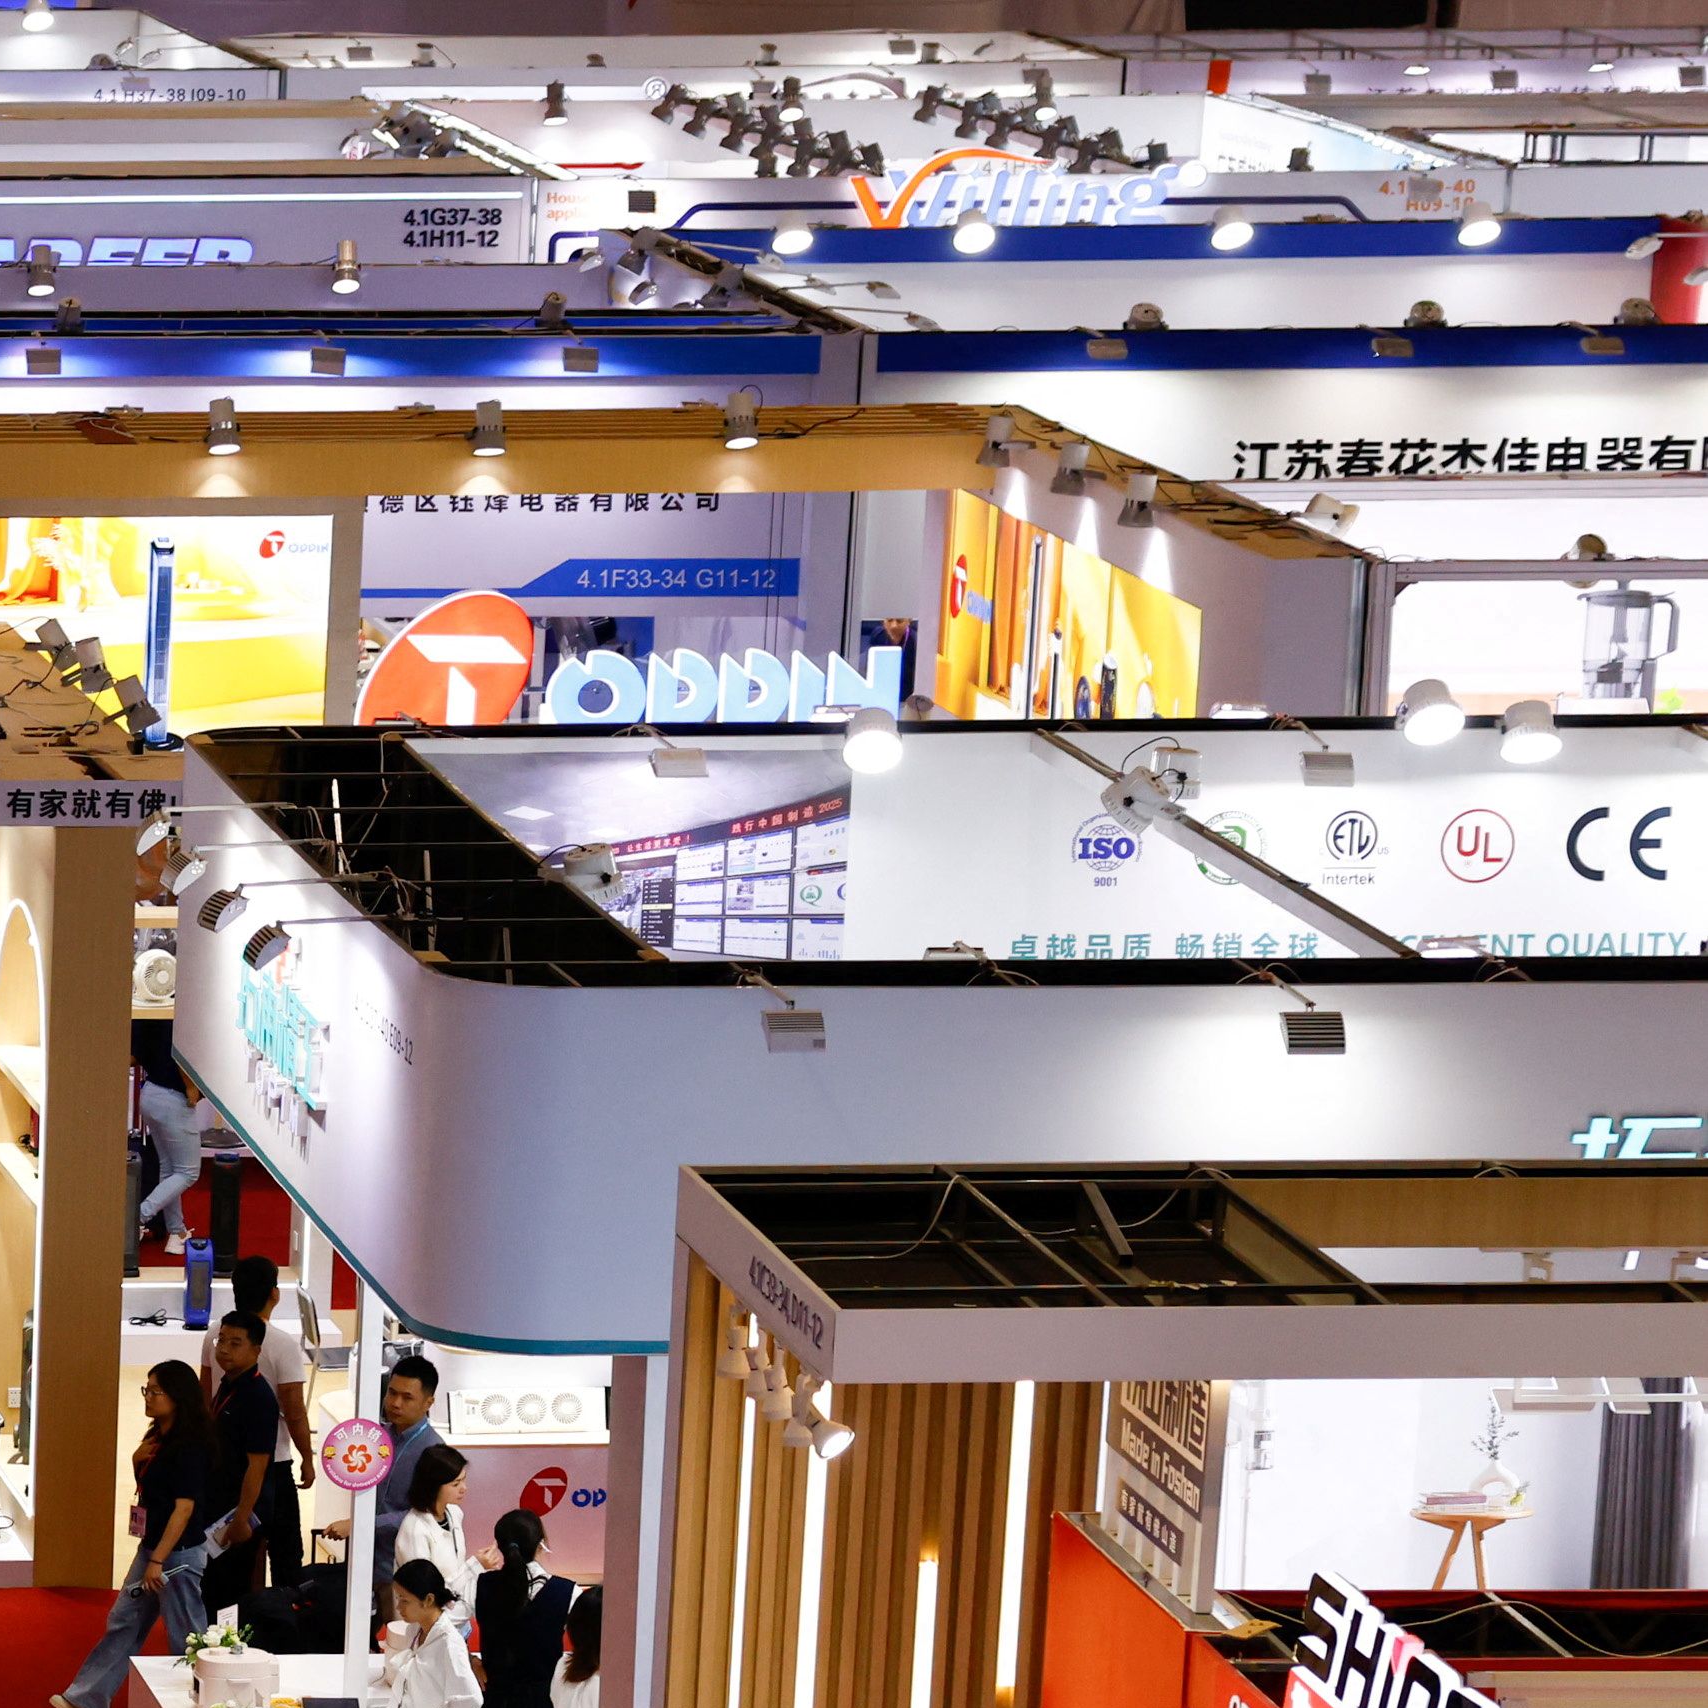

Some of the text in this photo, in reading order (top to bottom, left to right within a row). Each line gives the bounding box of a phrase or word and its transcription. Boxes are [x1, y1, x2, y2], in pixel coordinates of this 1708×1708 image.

[403, 208, 503, 226] 4.1G37-38
[403, 230, 499, 248] 4.1H11-12
[576, 569, 776, 589] 4.1F33-34 G11-12
[1078, 836, 1136, 861] ISO
[1457, 824, 1504, 863] UL
[1566, 806, 1671, 881] CE
[1093, 876, 1118, 888] 9001
[1322, 873, 1376, 885] Intertek
[1008, 933, 1320, 959] 卓越品质 畅销全球
[1121, 1417, 1202, 1515] Made in Foshan
